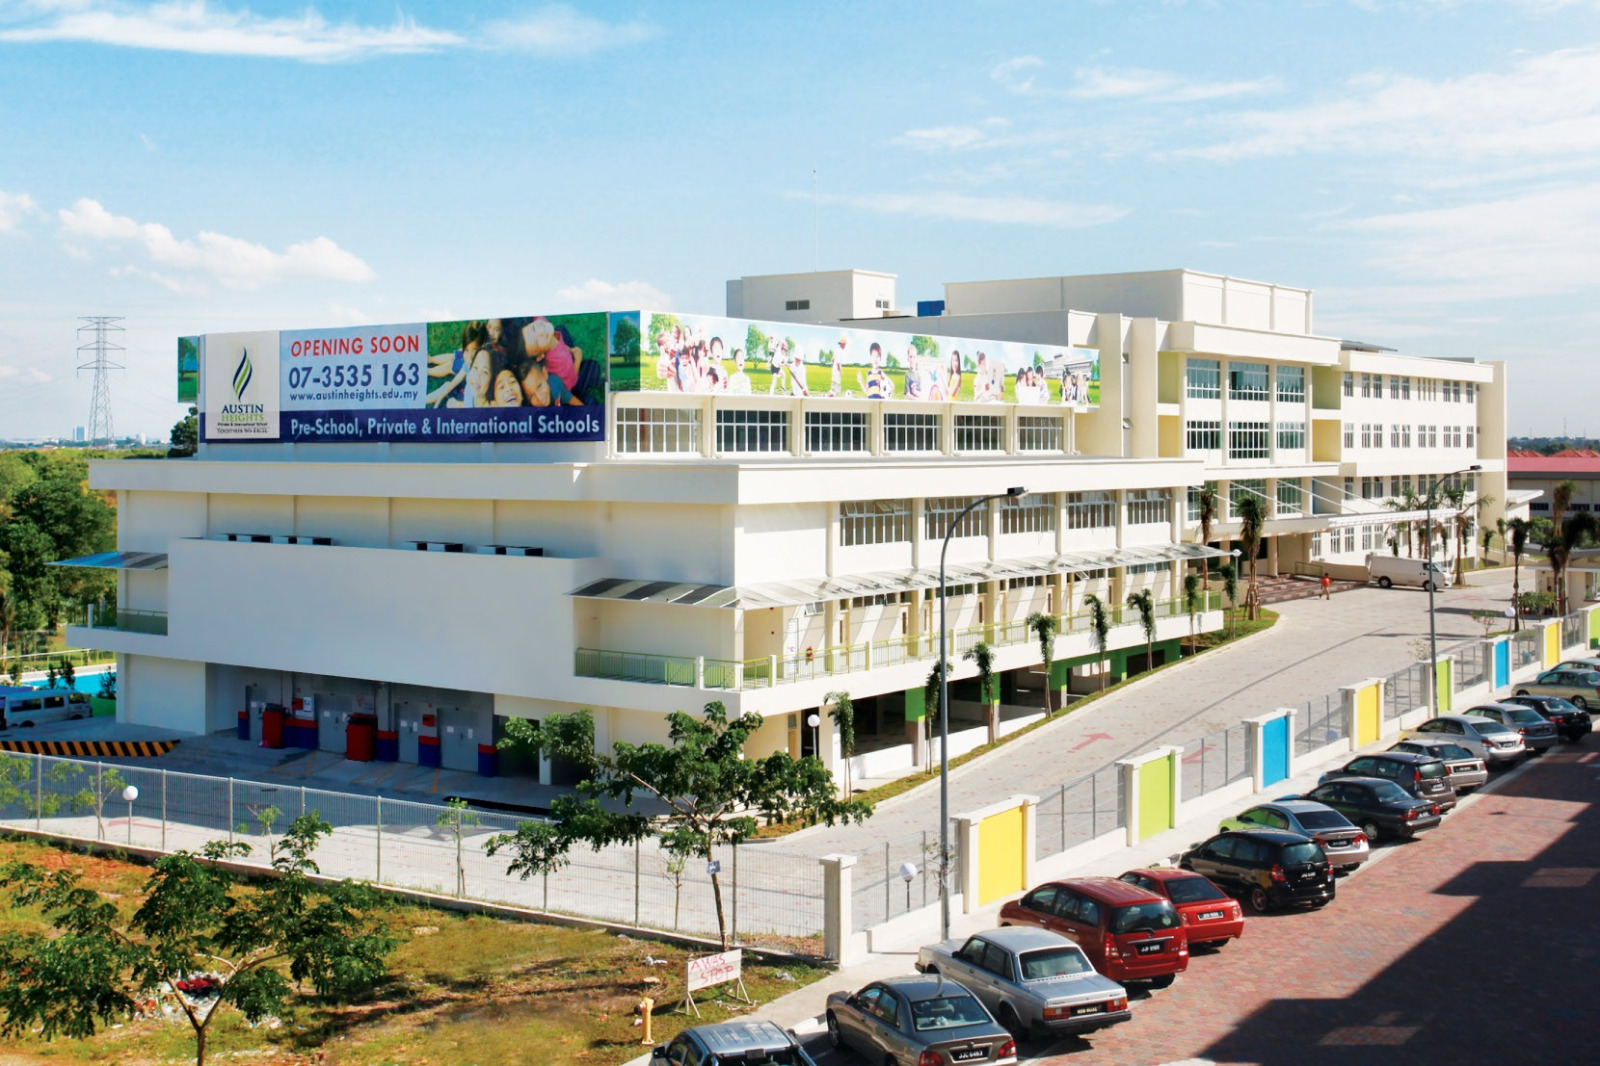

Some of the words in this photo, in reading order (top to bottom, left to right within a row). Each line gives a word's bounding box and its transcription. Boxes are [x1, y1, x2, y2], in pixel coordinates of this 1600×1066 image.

[290, 337, 364, 357] OPENING
[370, 335, 419, 354] SOON
[288, 364, 372, 389] 07-3535
[382, 362, 420, 386] 163
[289, 388, 418, 402] www.austinheights.edu.my
[221, 404, 264, 414] AUSTIN
[221, 413, 264, 422] HEIGHTS
[291, 417, 363, 437] Pre-School,
[367, 416, 416, 434] Private
[421, 417, 432, 434] &
[436, 415, 532, 434] International
[537, 413, 600, 433] Schools
[700, 964, 734, 984] STOP
